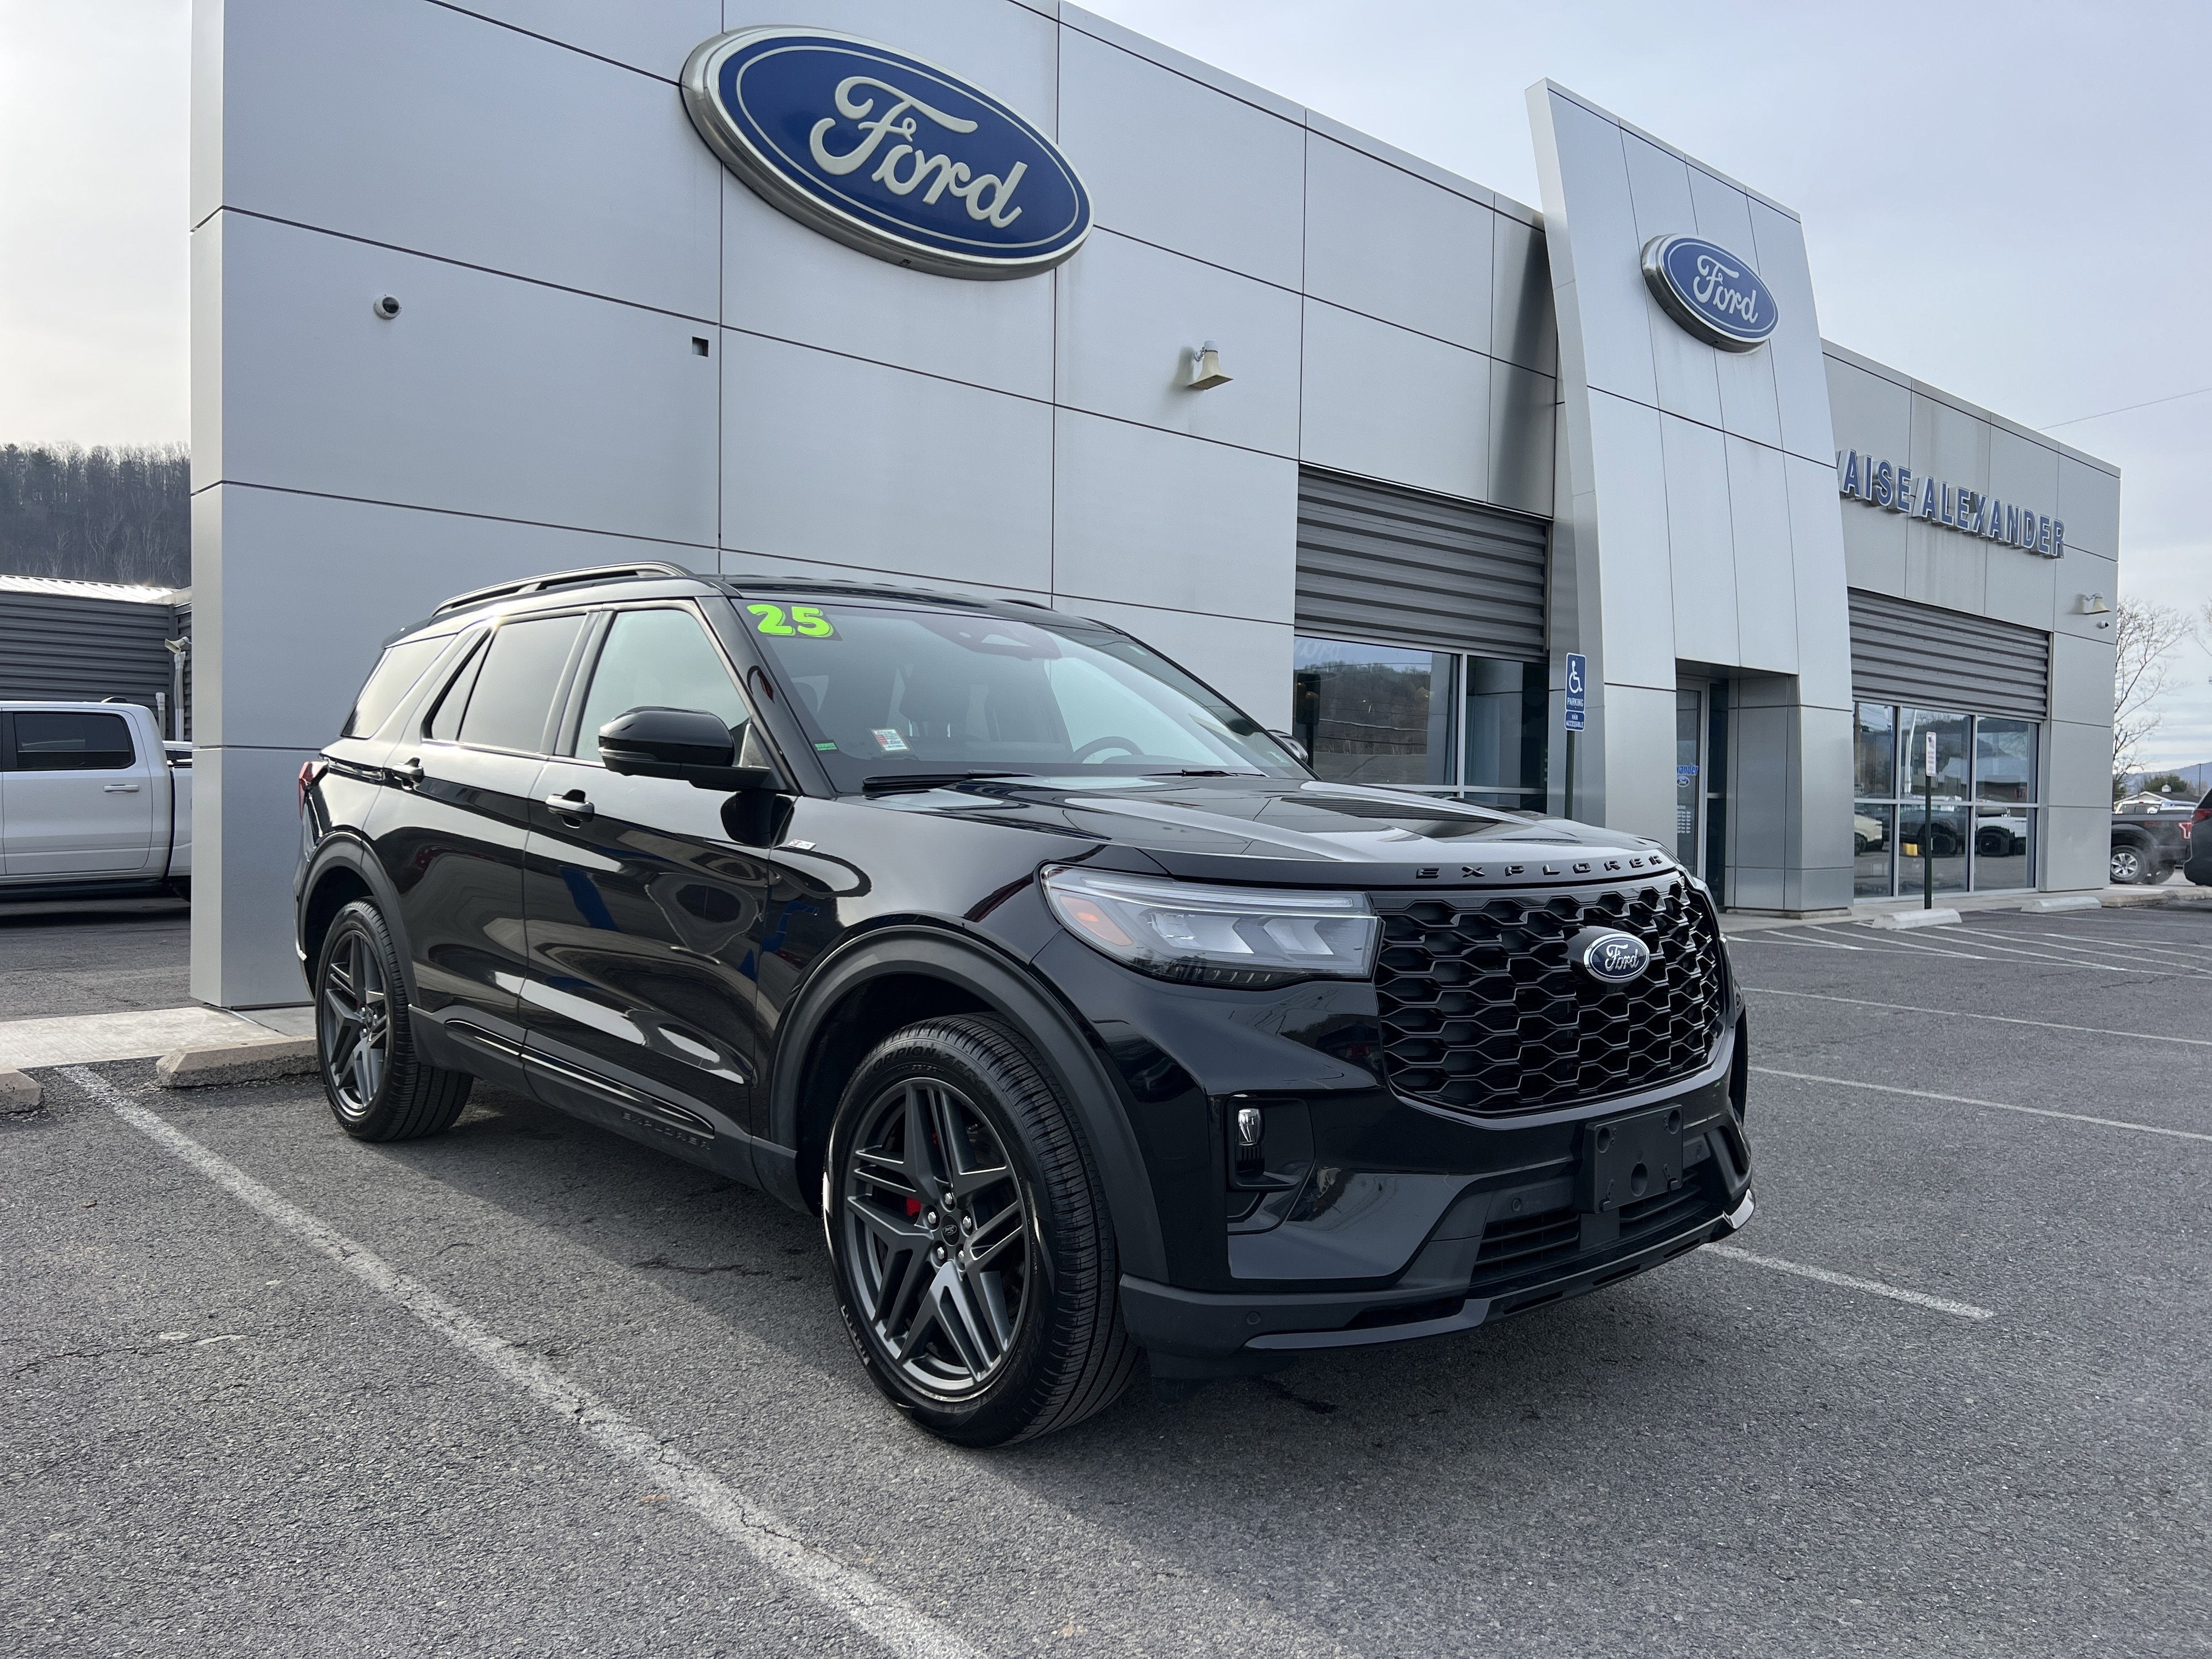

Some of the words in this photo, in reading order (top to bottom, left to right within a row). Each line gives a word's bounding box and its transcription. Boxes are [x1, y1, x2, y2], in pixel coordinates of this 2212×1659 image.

[809, 76, 1028, 229] Ford
[1693, 255, 1758, 324] Ford
[1919, 475, 2064, 559] ALEXANDER
[747, 603, 834, 638] 25
[1567, 697, 1584, 707] PARKING
[1566, 720, 1584, 728] ACCESSIBLE
[1415, 855, 1663, 879] EXPLORER
[1604, 944, 1640, 972] Ford
